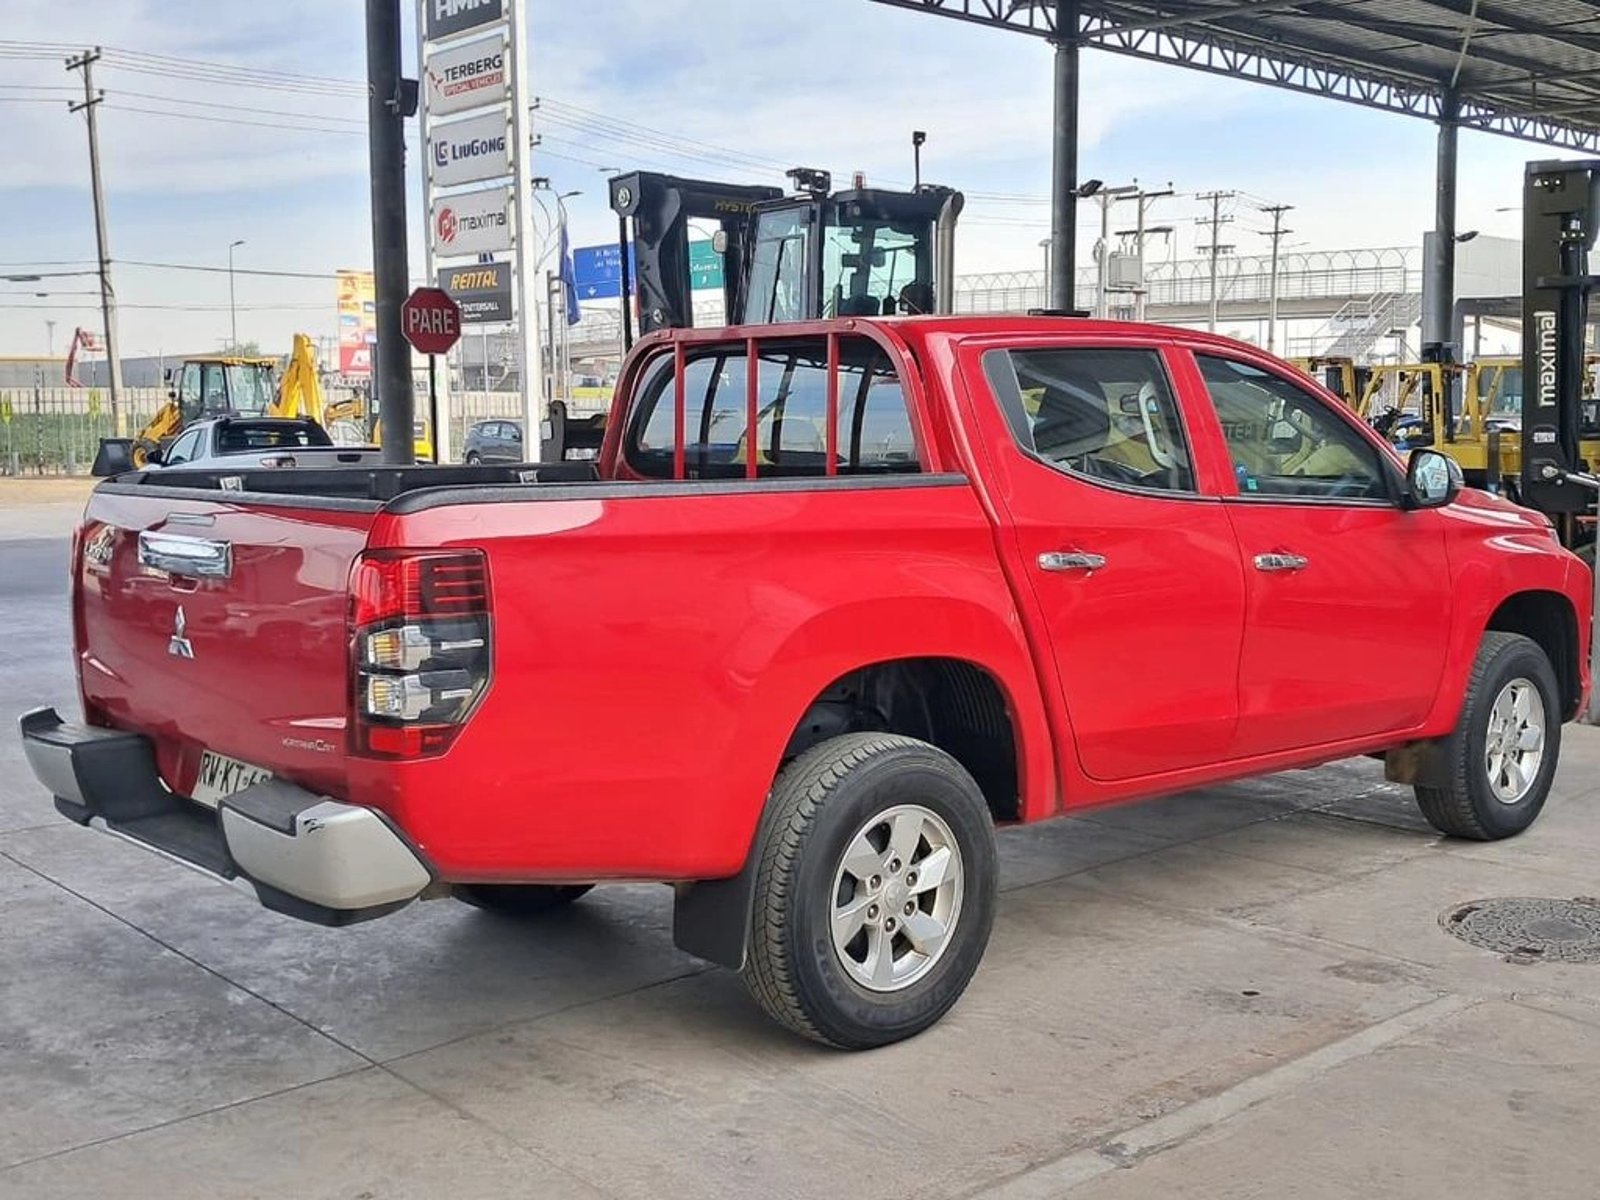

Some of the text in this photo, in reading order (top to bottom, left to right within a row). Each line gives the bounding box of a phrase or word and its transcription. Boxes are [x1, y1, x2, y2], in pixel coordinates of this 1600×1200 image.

[444, 54, 503, 81] TERBERG
[459, 206, 507, 231] maximal
[450, 270, 499, 290] RENTAL
[408, 307, 455, 335] PARE
[1533, 311, 1556, 407] maximal
